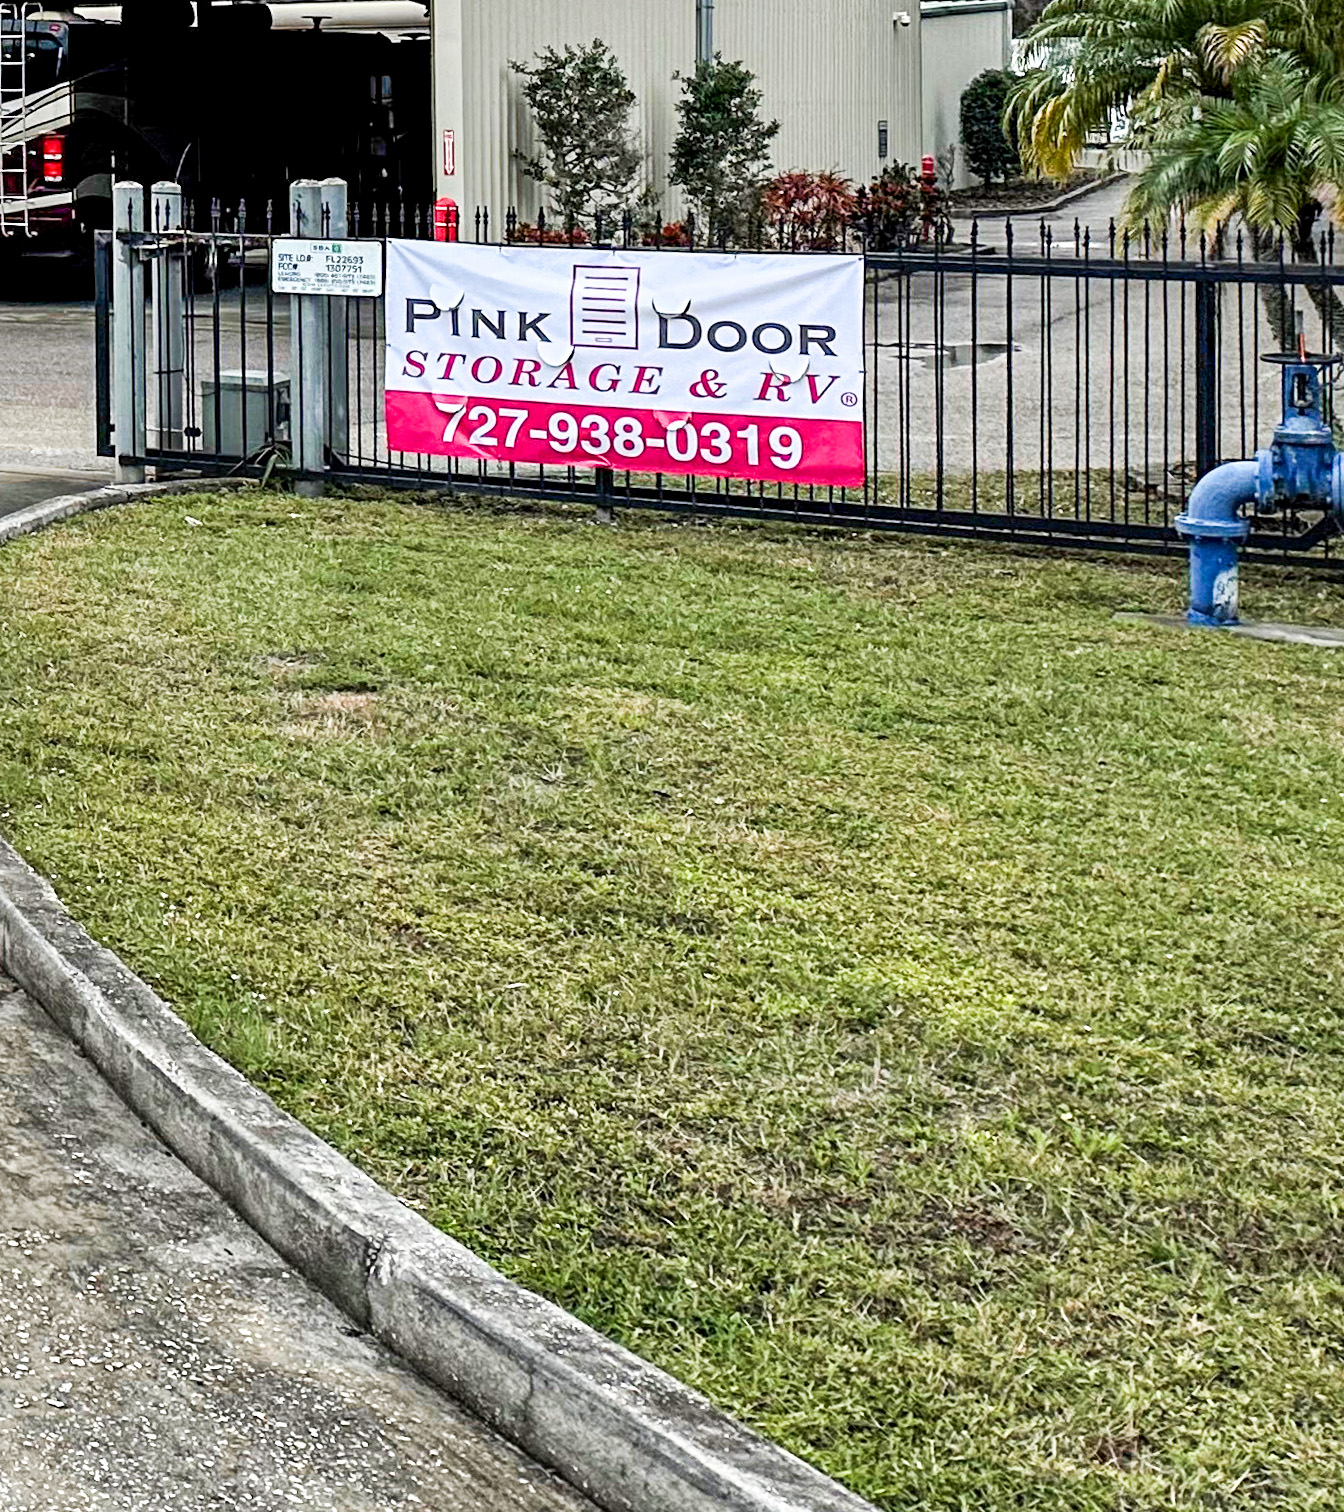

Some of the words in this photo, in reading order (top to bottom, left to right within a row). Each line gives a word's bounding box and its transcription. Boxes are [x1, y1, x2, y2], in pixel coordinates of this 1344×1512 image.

[405, 297, 552, 343] PINK
[657, 312, 838, 357] DOOR
[401, 349, 664, 395] STORAGE
[688, 368, 728, 399] &
[442, 402, 803, 471] 727-938-0319
